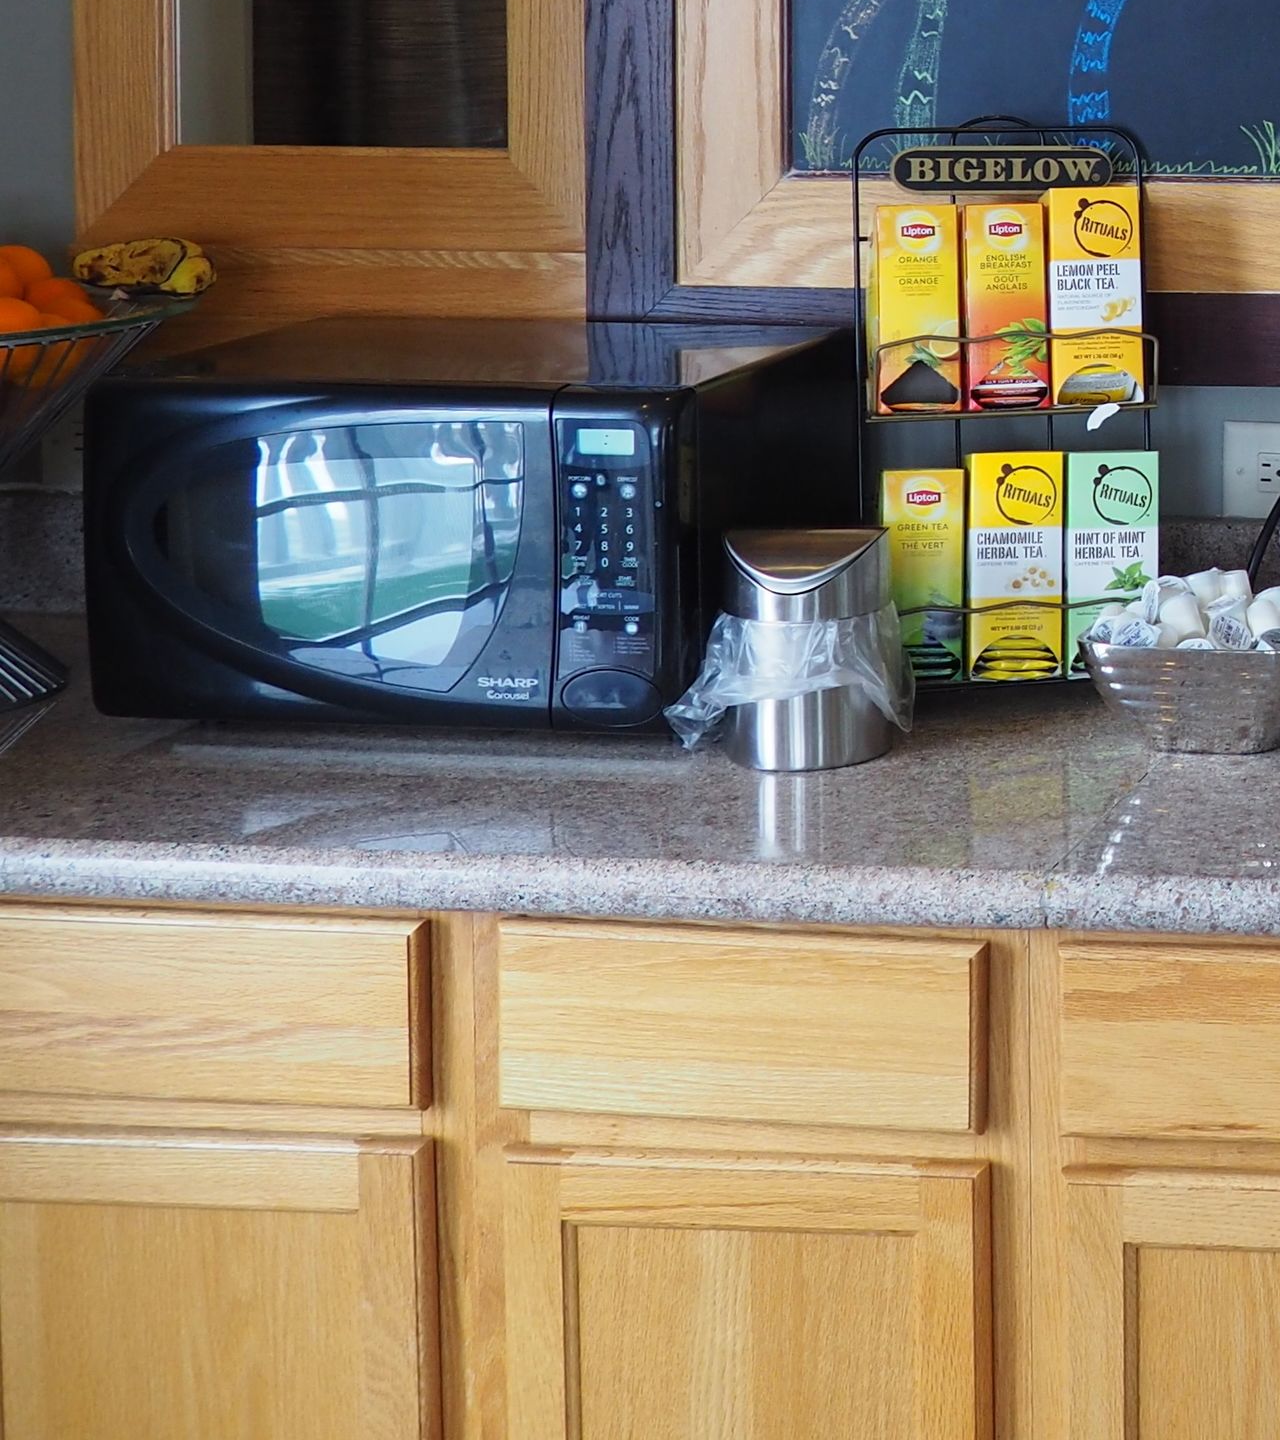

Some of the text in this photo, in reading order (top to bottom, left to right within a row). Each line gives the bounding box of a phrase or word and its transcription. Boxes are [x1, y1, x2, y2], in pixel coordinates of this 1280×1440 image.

[905, 157, 1094, 183] BIGELOW
[902, 225, 935, 238] Lipton
[989, 223, 1021, 236] Lipton
[1080, 215, 1129, 242] RITUALS
[898, 255, 939, 264] ORANGE
[986, 254, 1026, 262] ENGLISH
[979, 261, 1032, 270] BREAKFAST
[1057, 263, 1121, 277] LEMON PEEL
[898, 277, 940, 286] ORANGE
[985, 282, 1028, 291] ANGLAIS
[1057, 278, 1092, 291] BLACK
[908, 491, 940, 504] Lipton
[1002, 483, 1052, 509] RITUALS
[1099, 483, 1148, 509] RITUALS
[575, 507, 580, 517] 1
[601, 507, 608, 517] 2
[626, 508, 633, 518] 3
[574, 523, 582, 533] 4
[601, 524, 608, 534] 5
[626, 524, 634, 534] 6
[897, 522, 949, 532] GREEN TEA
[977, 531, 1043, 545] CHAMOMILE
[1074, 531, 1146, 545] HINT OF MINT
[575, 541, 582, 550] 7
[601, 541, 608, 551] 8
[626, 541, 634, 552] 9
[923, 541, 944, 550] VERT
[977, 546, 1019, 560] HERBAL
[1074, 546, 1116, 560] HERBAL
[601, 557, 608, 568] 0
[477, 676, 539, 688] SHARP
[486, 689, 530, 700] Carousel
